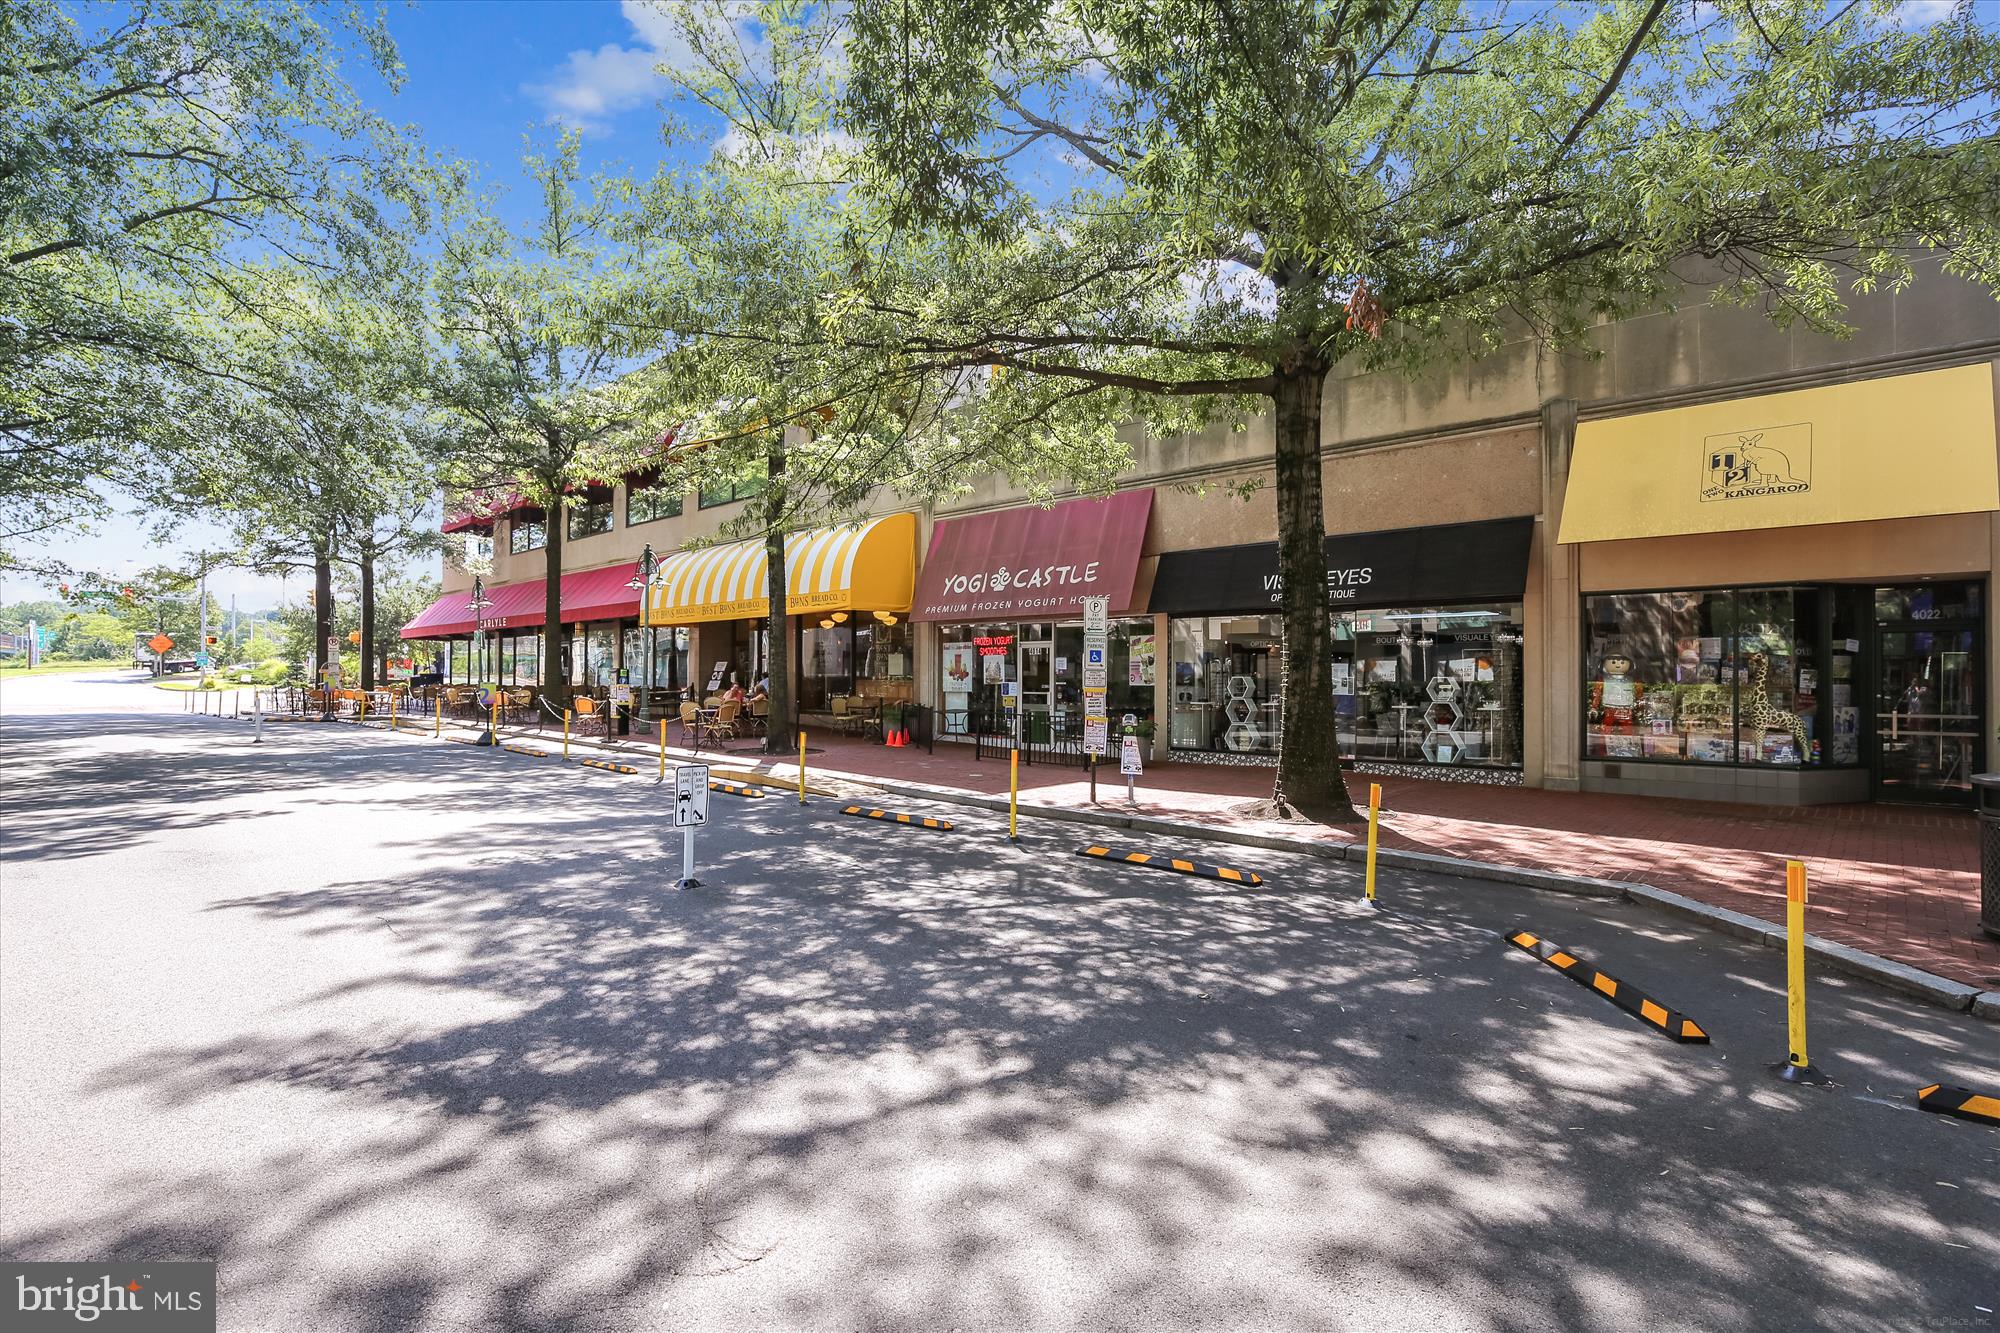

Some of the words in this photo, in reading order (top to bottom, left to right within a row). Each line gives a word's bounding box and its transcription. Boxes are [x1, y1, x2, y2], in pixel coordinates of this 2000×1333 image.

[1703, 486, 1719, 495] ONE
[1706, 489, 1725, 498] TWO
[943, 573, 988, 596] YOGI
[1013, 562, 1100, 589] CASTLE
[790, 596, 809, 608] BUNS
[811, 595, 828, 603] BREAD
[925, 604, 967, 614] PREMIUM
[972, 601, 1012, 611] FROZEN
[1018, 597, 1064, 608] YOGURT
[1093, 602, 1099, 611] P
[702, 606, 717, 616] BEST
[719, 604, 736, 614] BUNS
[1912, 609, 1942, 620] 4022
[480, 617, 507, 629] CARLYLE
[973, 636, 993, 646] FROZEN
[994, 635, 1014, 645] YOGURT
